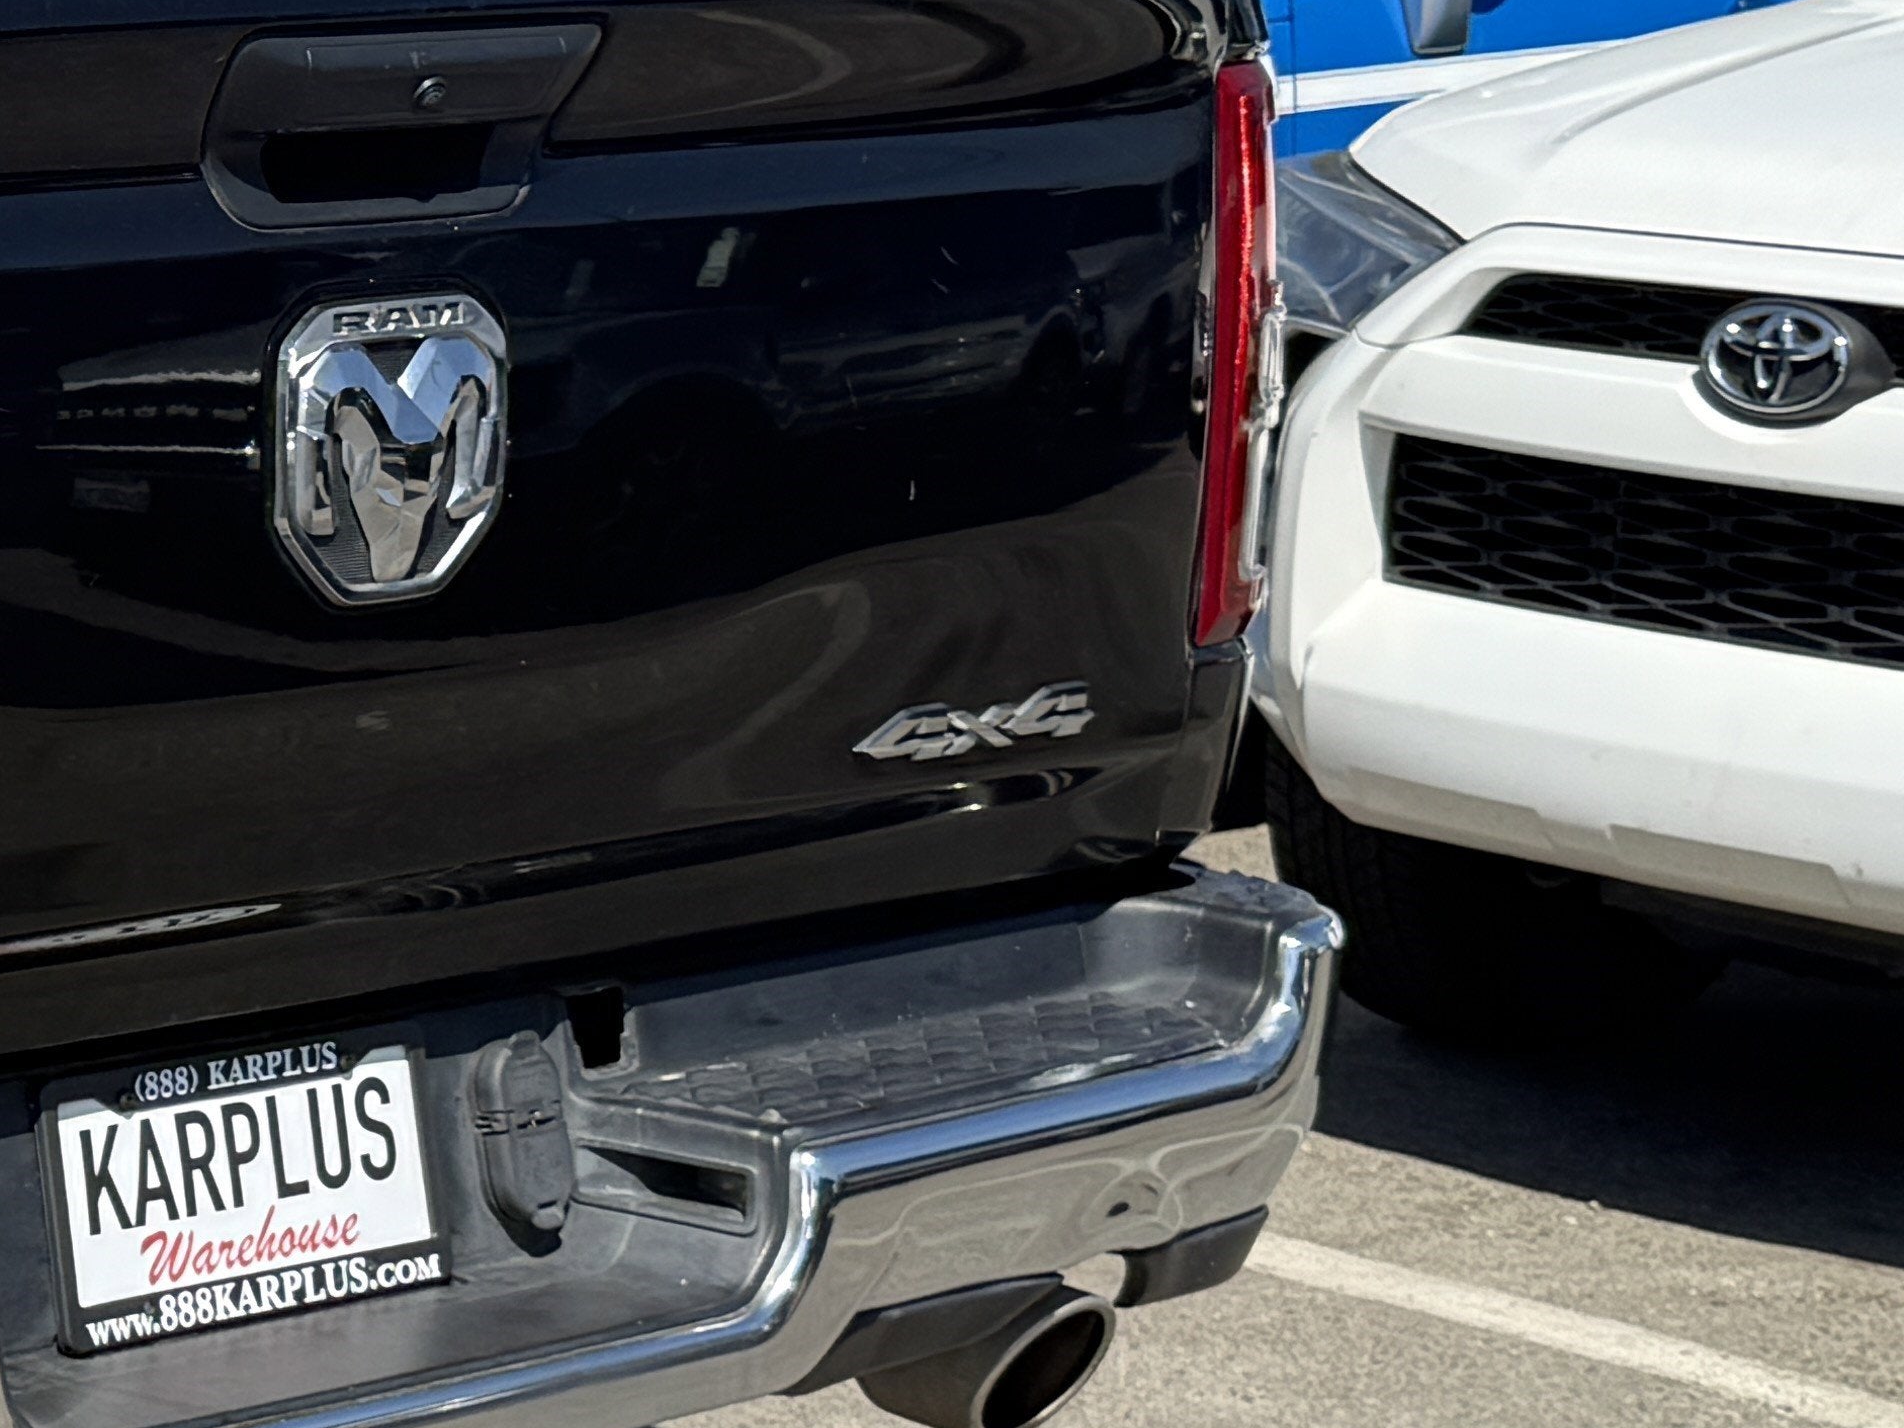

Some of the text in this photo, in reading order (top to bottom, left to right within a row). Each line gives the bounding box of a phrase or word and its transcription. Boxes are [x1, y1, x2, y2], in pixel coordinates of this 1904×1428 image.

[332, 302, 465, 336] RAM
[133, 1041, 338, 1103] (888) KARPLUS
[78, 1076, 397, 1236] KARPLUS
[139, 1204, 360, 1286] Warehouse
